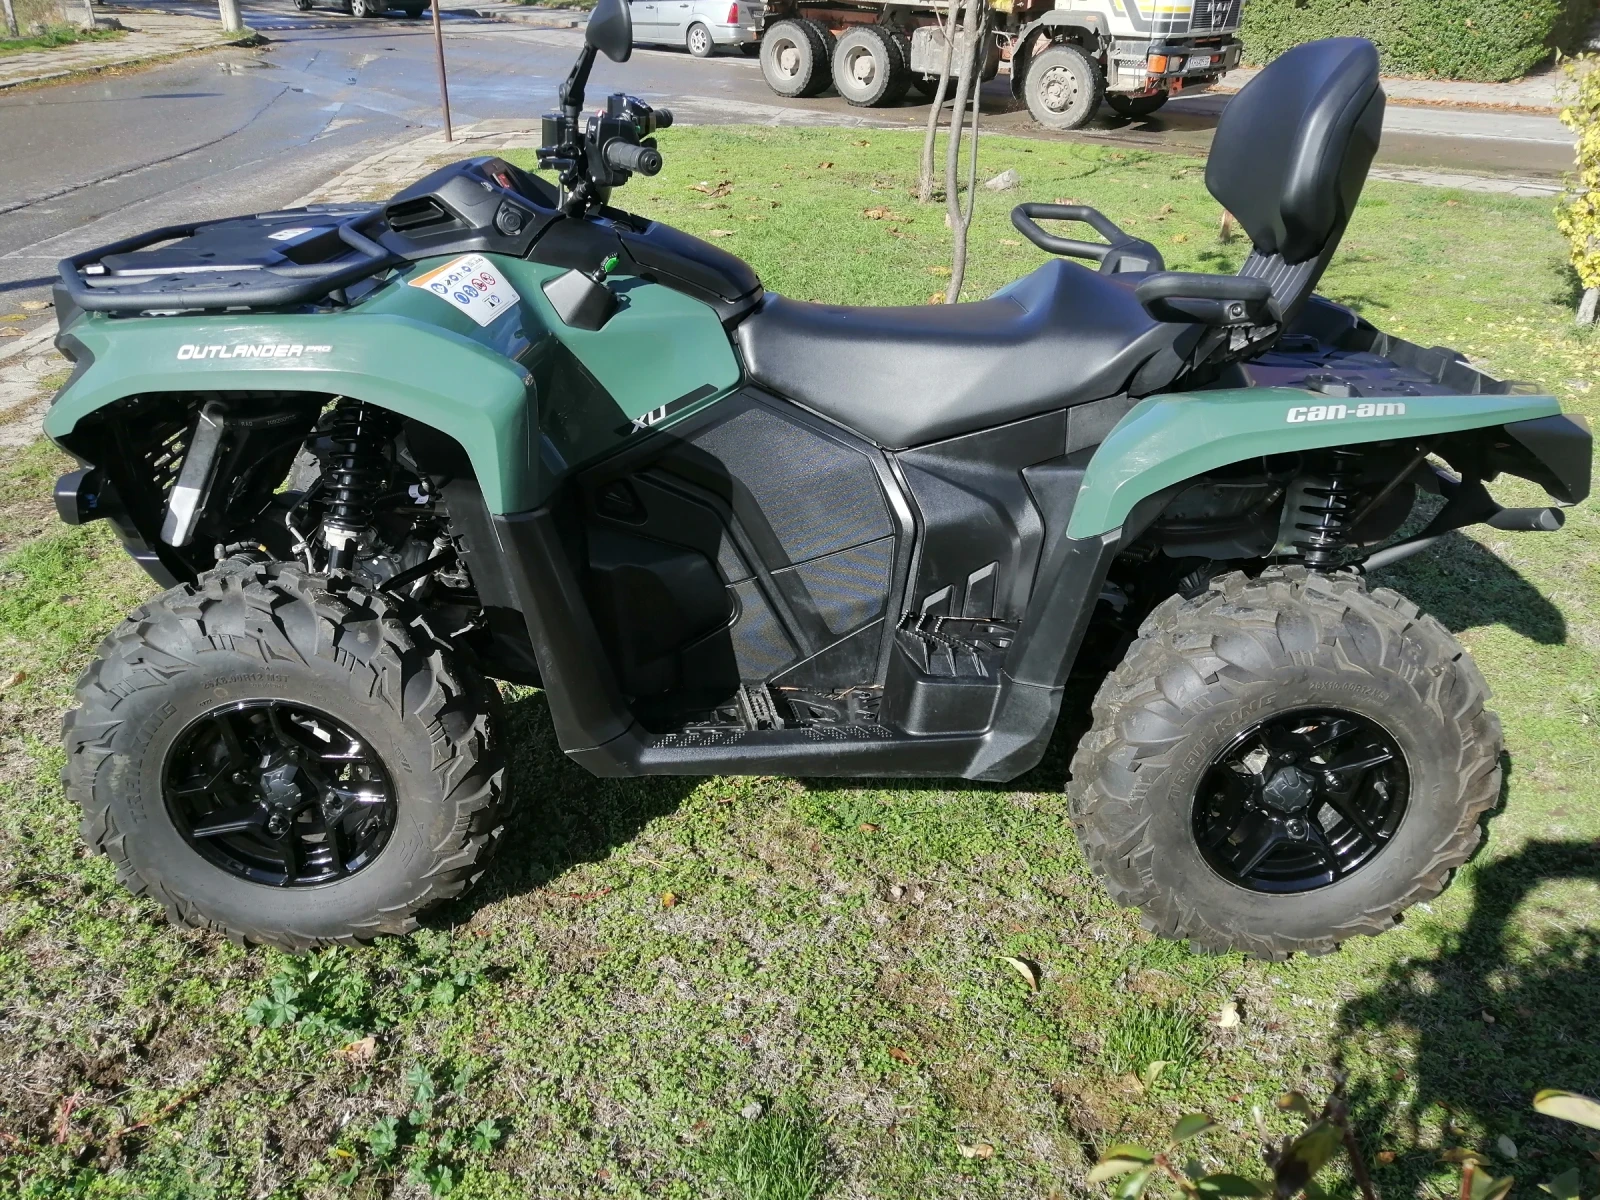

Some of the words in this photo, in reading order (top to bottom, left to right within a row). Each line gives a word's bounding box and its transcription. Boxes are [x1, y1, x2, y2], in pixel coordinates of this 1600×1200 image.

[177, 344, 304, 360] OUTLANDER
[303, 345, 333, 353] PRO
[1286, 402, 1406, 423] can-am
[130, 700, 178, 755] KING
[1167, 736, 1215, 801] TRAIL
[1213, 691, 1277, 735] KING
